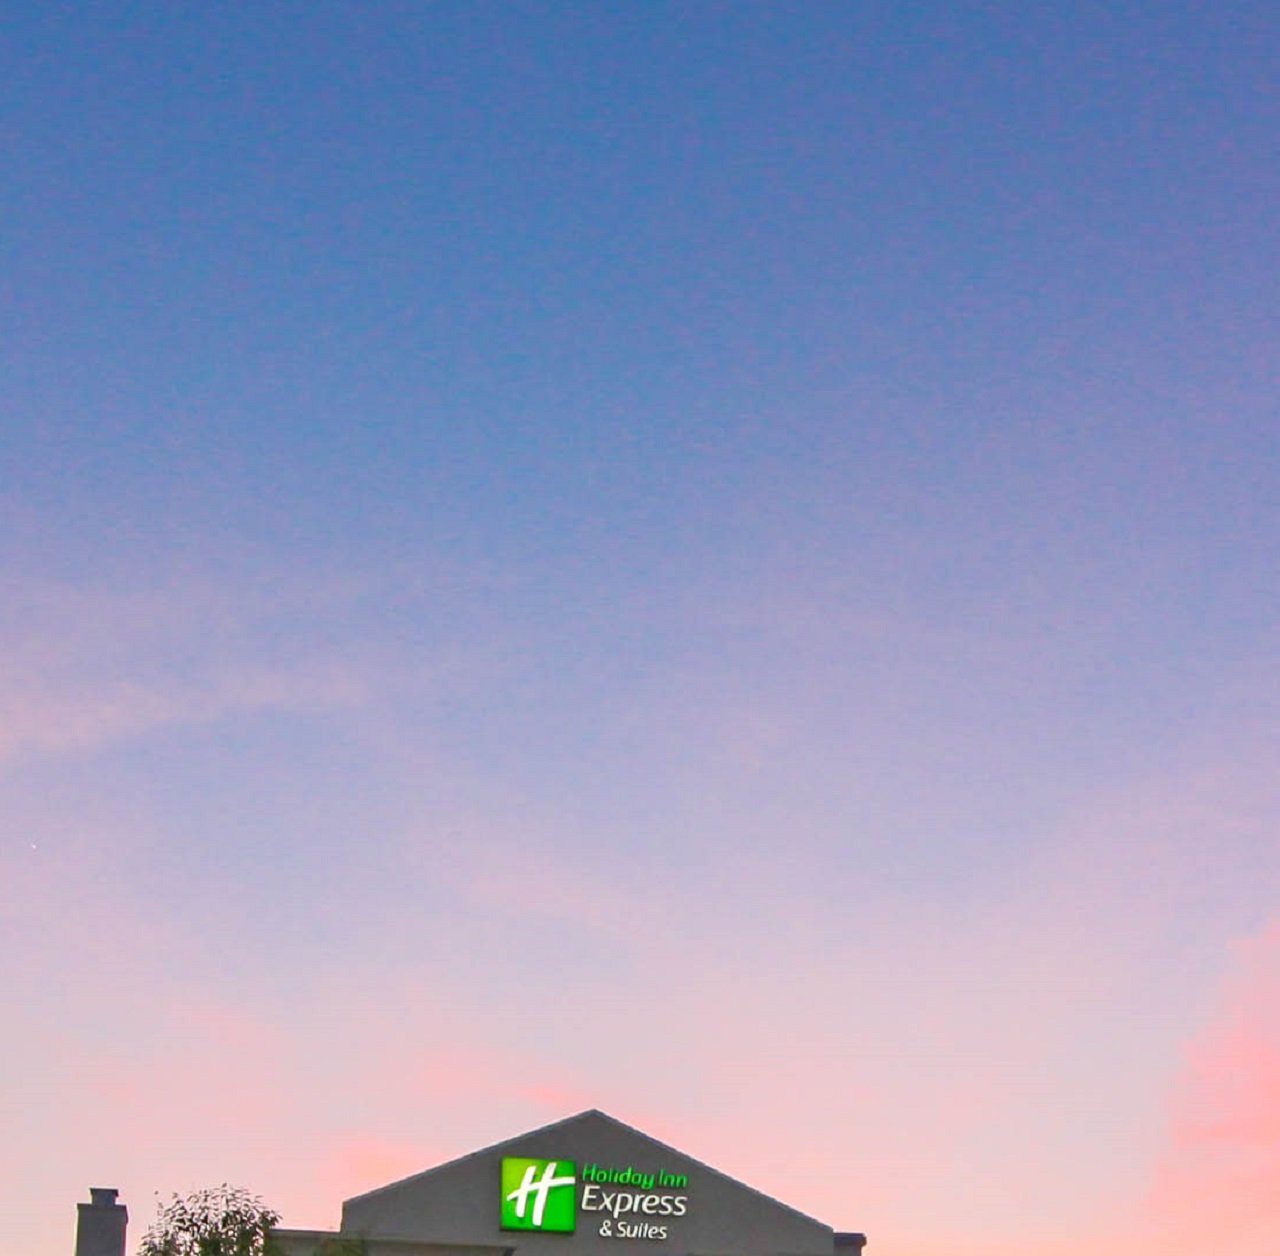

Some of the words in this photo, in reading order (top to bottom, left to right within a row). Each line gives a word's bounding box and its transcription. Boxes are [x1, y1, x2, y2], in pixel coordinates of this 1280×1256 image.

[582, 1163, 655, 1190] Holiday
[658, 1168, 688, 1188] Inn
[581, 1184, 688, 1219] Express
[599, 1219, 612, 1237] &
[616, 1221, 668, 1239] Suites
